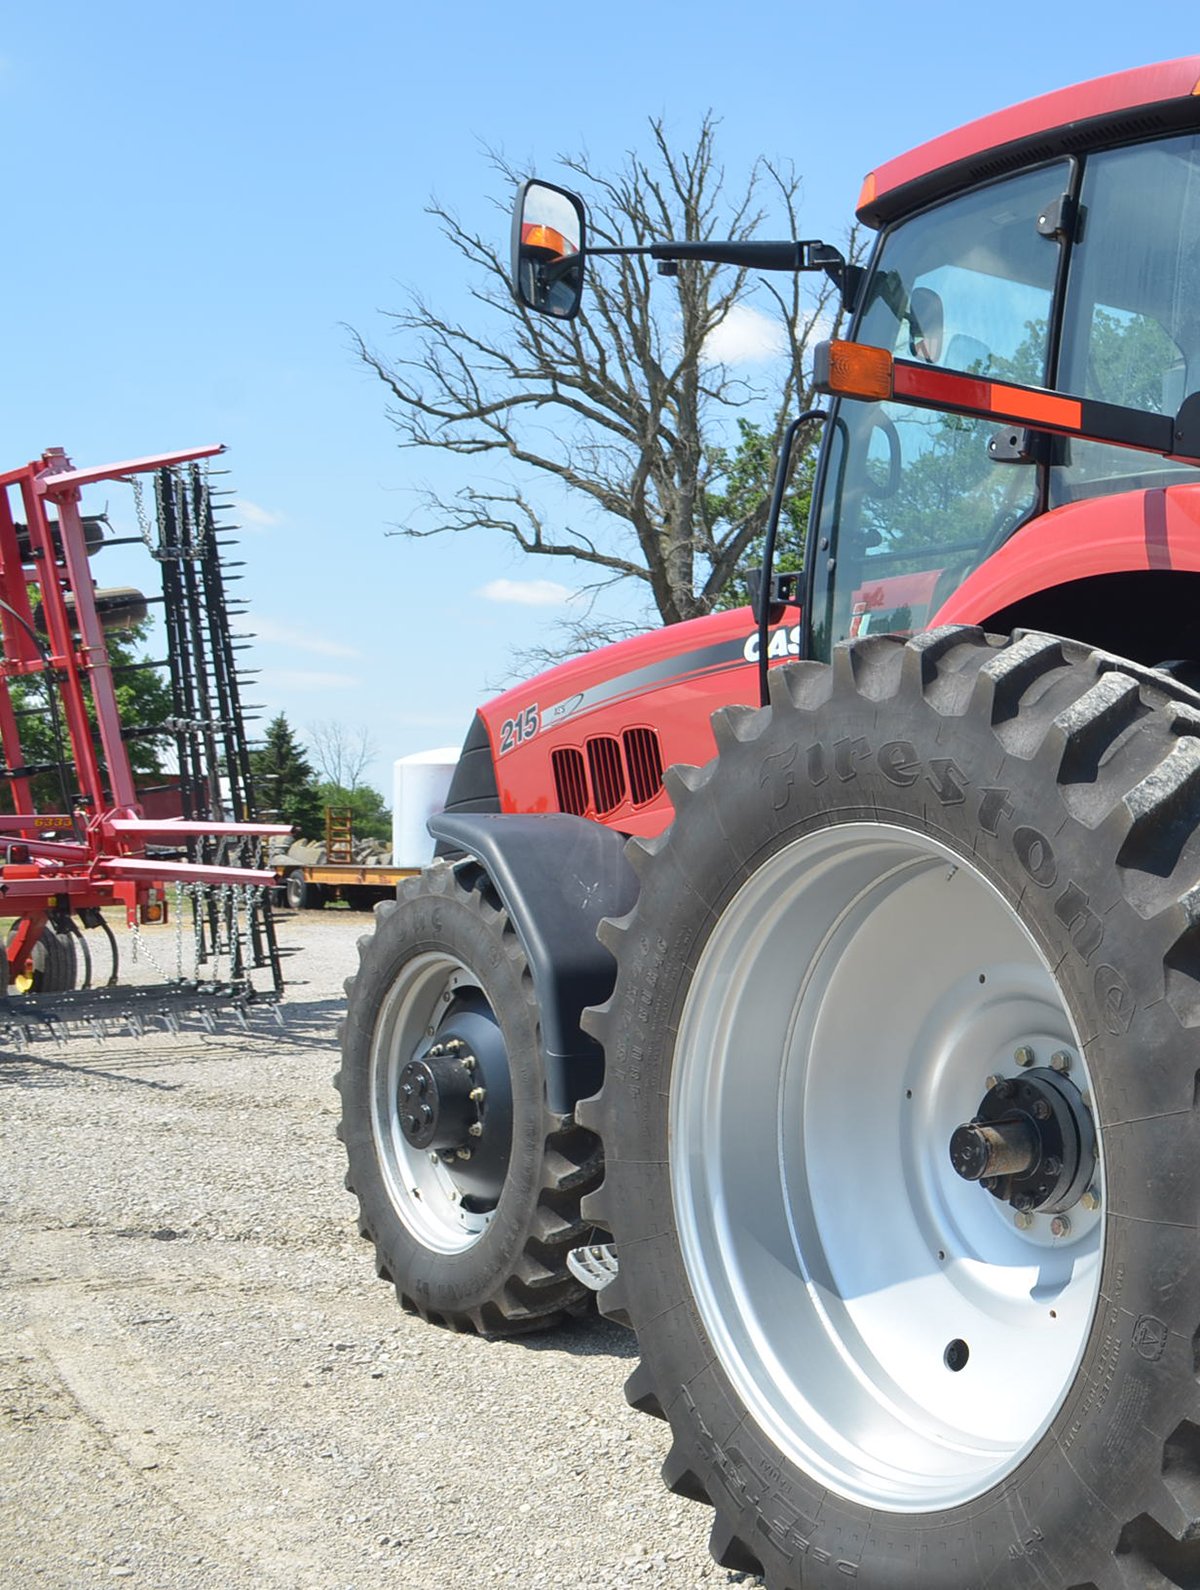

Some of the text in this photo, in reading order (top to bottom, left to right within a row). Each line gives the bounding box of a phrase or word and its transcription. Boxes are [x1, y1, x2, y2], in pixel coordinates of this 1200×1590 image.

[743, 625, 800, 662] CAS
[500, 703, 539, 755] 215
[760, 736, 1136, 1036] Firestone
